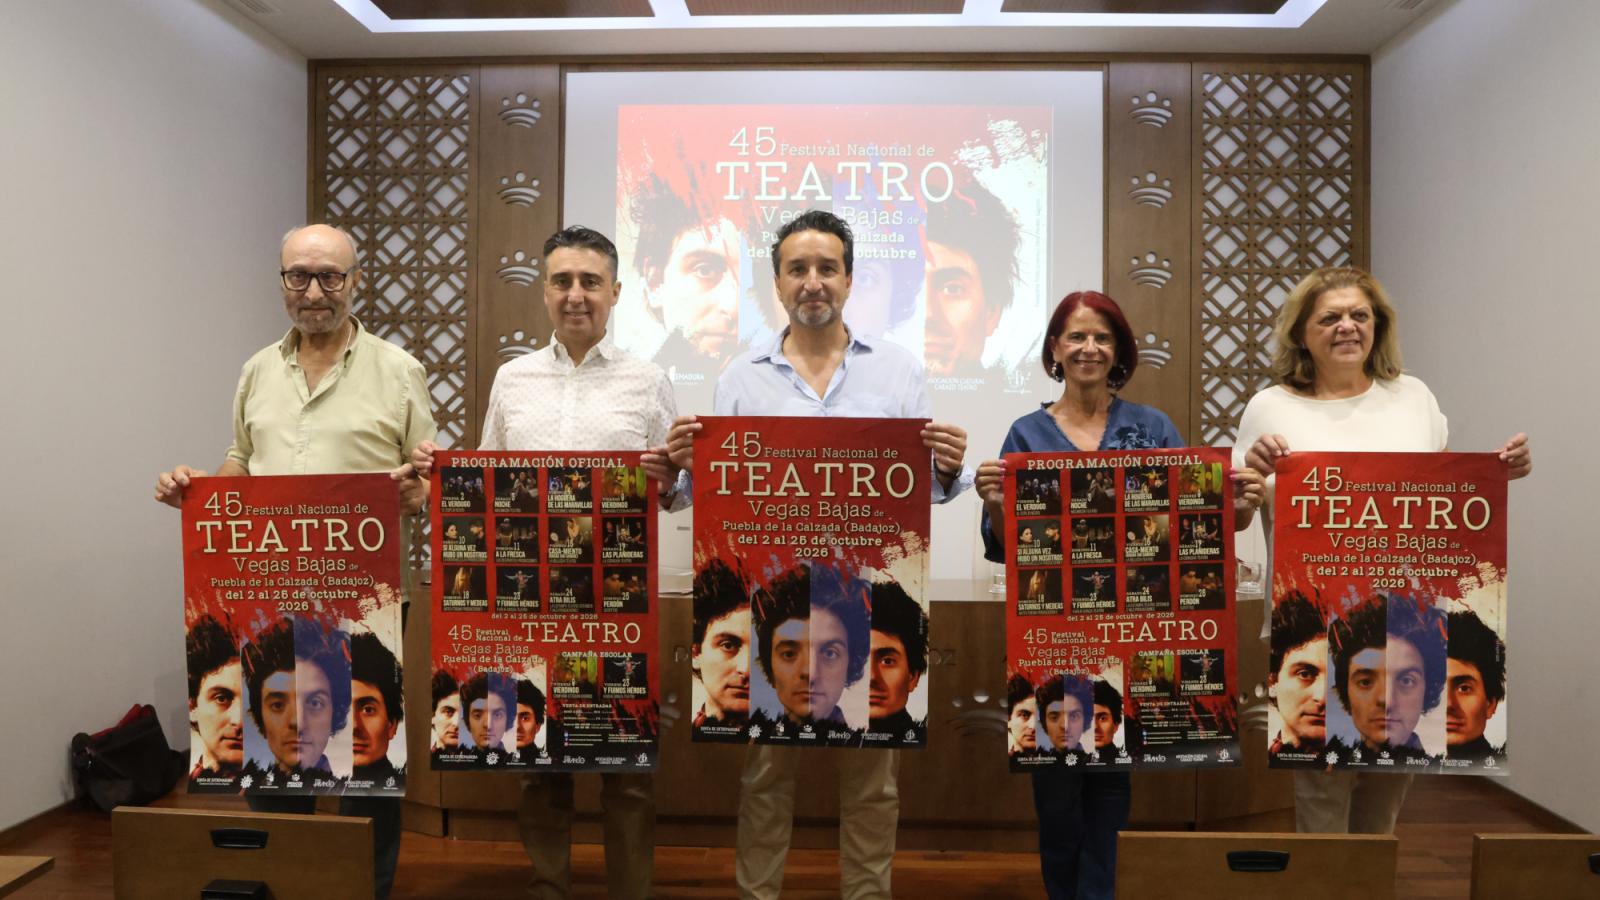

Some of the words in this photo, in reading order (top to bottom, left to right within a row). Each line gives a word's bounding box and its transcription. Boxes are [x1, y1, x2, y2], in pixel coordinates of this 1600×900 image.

[728, 126, 777, 157] 45
[780, 142, 841, 157] Festival
[847, 143, 912, 157] Nacional
[916, 145, 935, 157] de
[716, 161, 954, 202] TEATRO
[842, 207, 903, 228] Bajas
[857, 250, 917, 259] octubre
[720, 432, 762, 458] 45
[764, 448, 817, 458] Festival
[822, 448, 878, 458] Nacional
[883, 448, 898, 458] de
[451, 456, 564, 468] PROGRAMACIÓN
[569, 458, 626, 468] OFICIAL
[1027, 456, 1142, 470] PROGRAMACIÓN
[1146, 455, 1202, 467] OFICIAL
[710, 461, 914, 498] TEATRO
[1302, 466, 1342, 492] 45
[1345, 481, 1396, 492] Festival
[1401, 482, 1456, 492] Nacional
[1460, 482, 1476, 492] de
[204, 491, 243, 517] 45
[245, 505, 295, 516] Festival
[298, 504, 350, 514] Nacional
[354, 504, 368, 513] de
[748, 500, 810, 520] Vegas
[817, 501, 870, 520] Bajas
[1291, 496, 1491, 530] TEATRO
[723, 521, 761, 531] Puebla
[765, 521, 778, 531] de
[782, 522, 792, 532] la
[796, 522, 840, 532] Calzada
[844, 522, 900, 534] (Badajoz)
[196, 517, 385, 553] TEATRO
[738, 535, 758, 544] del
[762, 535, 770, 544] 2
[774, 535, 786, 545] al
[811, 536, 827, 546] de
[830, 536, 882, 546] octubre
[1328, 533, 1388, 552] Vegas
[1396, 534, 1448, 552] Bajas
[795, 548, 828, 557] 2026
[1302, 553, 1340, 563] Puebla
[1344, 554, 1357, 563] de
[1360, 554, 1371, 563] la
[1374, 554, 1418, 564] Calzada
[1421, 554, 1476, 565] (Badajoz)
[233, 557, 290, 575] Vegas
[296, 556, 346, 575] Bajas
[1317, 567, 1336, 576] del
[1341, 567, 1348, 576] 2
[1352, 567, 1364, 576] al
[1389, 567, 1404, 576] de
[1408, 568, 1458, 577] octubre
[211, 578, 246, 586] Puebla
[249, 578, 261, 586] de
[265, 577, 274, 586] la
[277, 577, 318, 586] Calzada
[322, 575, 374, 587] (Badajoz)
[1372, 579, 1406, 588] 2026
[226, 591, 243, 600] del
[248, 591, 254, 600] 2
[258, 591, 269, 600] al
[292, 590, 306, 599] de
[309, 590, 358, 599] octubre
[278, 602, 309, 611] 2026
[447, 625, 472, 640] 45
[476, 628, 508, 636] Festival
[521, 622, 641, 644] TEATRO
[1023, 628, 1048, 644] 45
[1098, 619, 1218, 644] TEATRO
[451, 644, 493, 655] Vegas
[496, 644, 529, 656] Bajas
[562, 650, 598, 658] CAMPAÑA
[1027, 646, 1070, 658] Vegas
[1072, 646, 1105, 658] Bajas
[1138, 649, 1174, 657] CAMPAÑA
[1177, 648, 1209, 656] ESCOLAR
[443, 655, 476, 663] Puebla
[493, 656, 503, 664] la
[506, 656, 543, 664] Calzada
[1019, 658, 1052, 667] Puebla
[1055, 658, 1066, 666] de
[1069, 658, 1079, 666] la
[1082, 656, 1121, 665] Calzada
[473, 665, 514, 674] (Badajoz)
